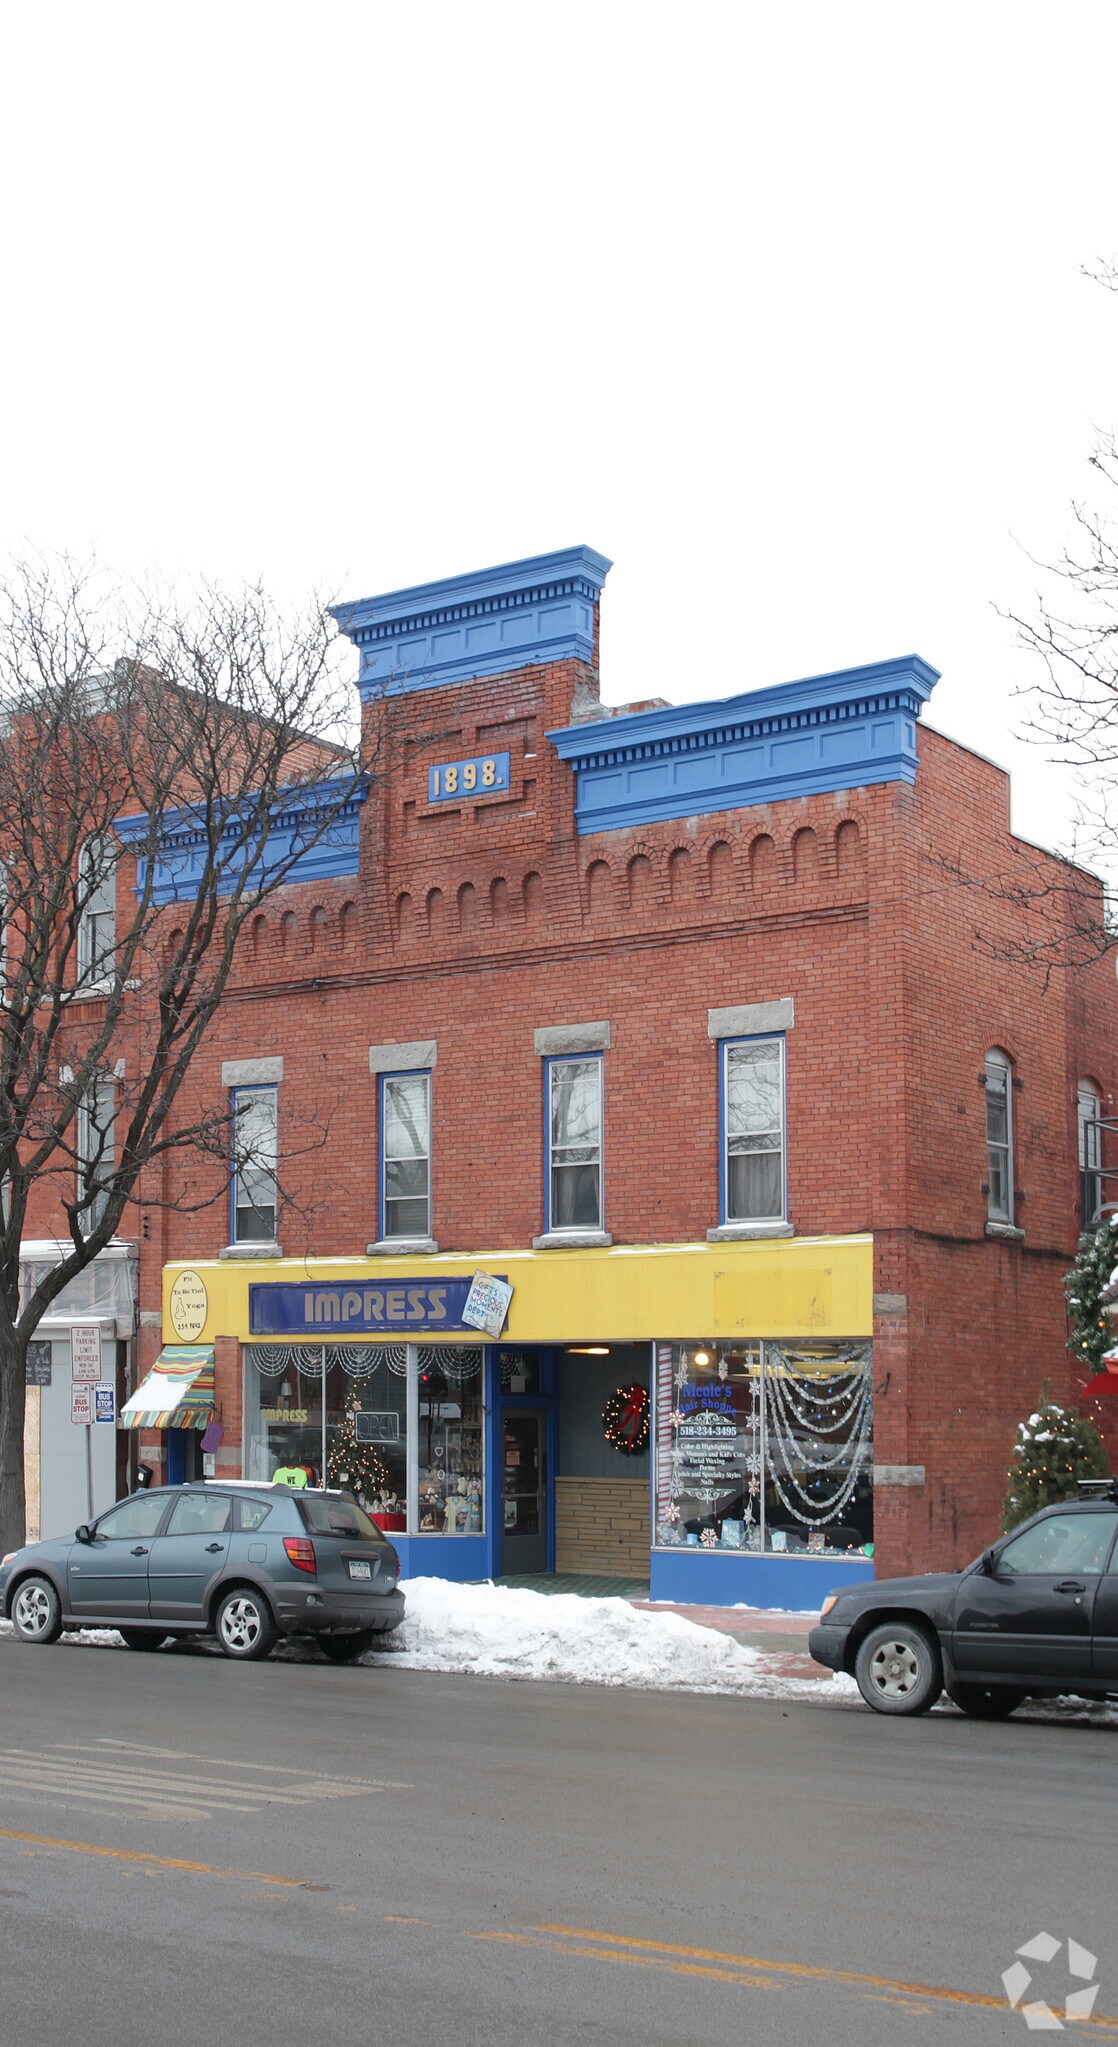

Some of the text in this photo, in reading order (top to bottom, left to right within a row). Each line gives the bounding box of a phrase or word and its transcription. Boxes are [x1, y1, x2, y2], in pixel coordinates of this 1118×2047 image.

[304, 1289, 447, 1322] IMPRESS
[471, 1295, 504, 1317] MOMENTS
[472, 1288, 504, 1309] PRECIOUS
[682, 1382, 732, 1398] Nicole's
[96, 1400, 113, 1408] STOP
[701, 1398, 738, 1416] Shoppe
[358, 1415, 398, 1440] OPEN
[680, 1426, 737, 1436] 518-234-3495
[701, 1443, 734, 1451] Highlighting
[705, 1458, 726, 1466] Waxing
[726, 1472, 742, 1480] Styles
